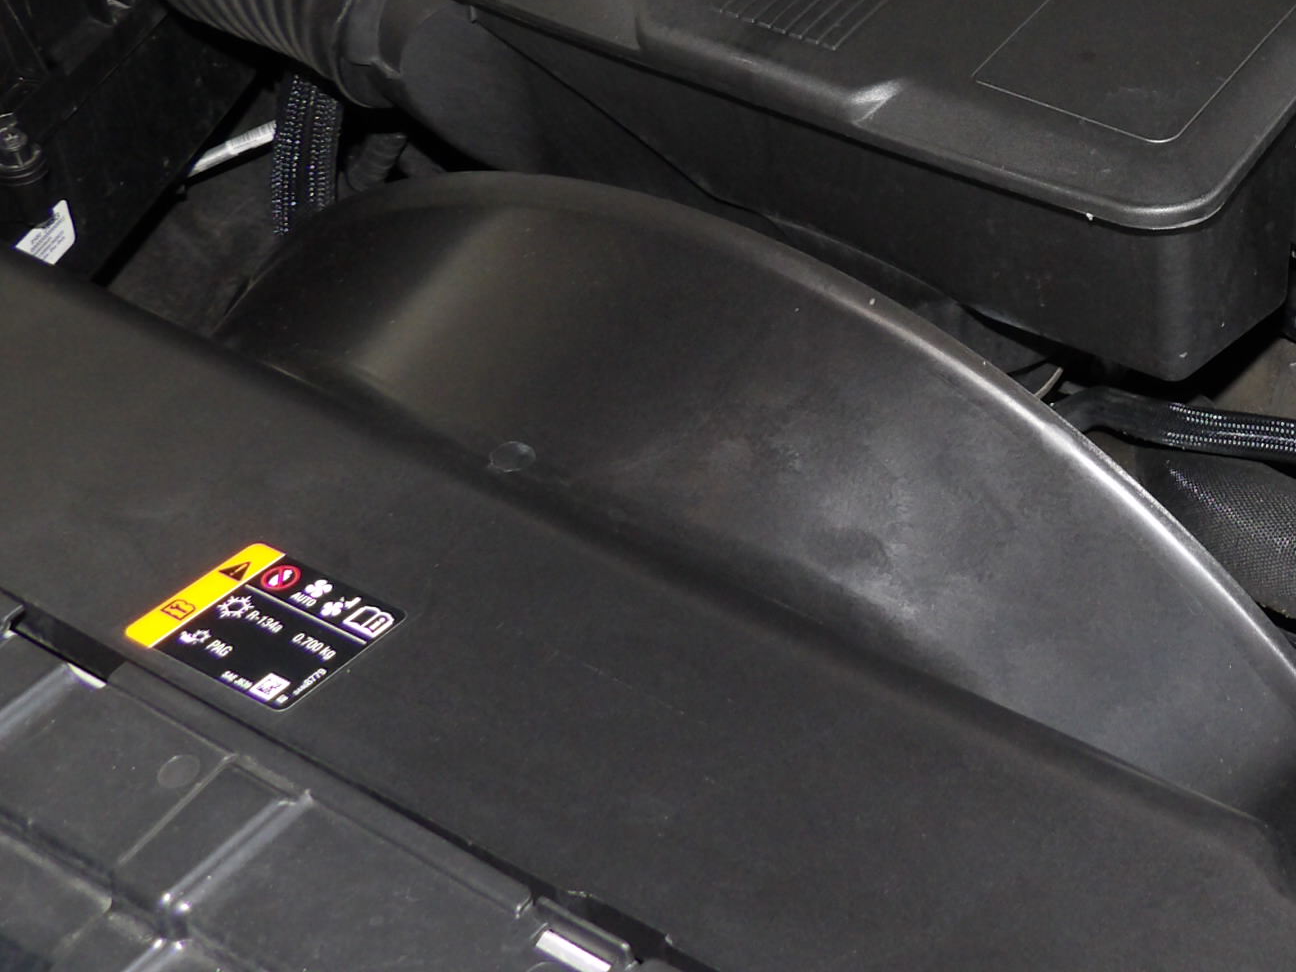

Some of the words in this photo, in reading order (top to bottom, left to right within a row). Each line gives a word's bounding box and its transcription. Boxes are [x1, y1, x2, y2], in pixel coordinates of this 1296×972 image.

[290, 591, 317, 607] AUTO
[245, 609, 284, 633] R-134a
[291, 632, 325, 652] 0.700
[319, 645, 336, 661] kg
[205, 639, 234, 657] PAG
